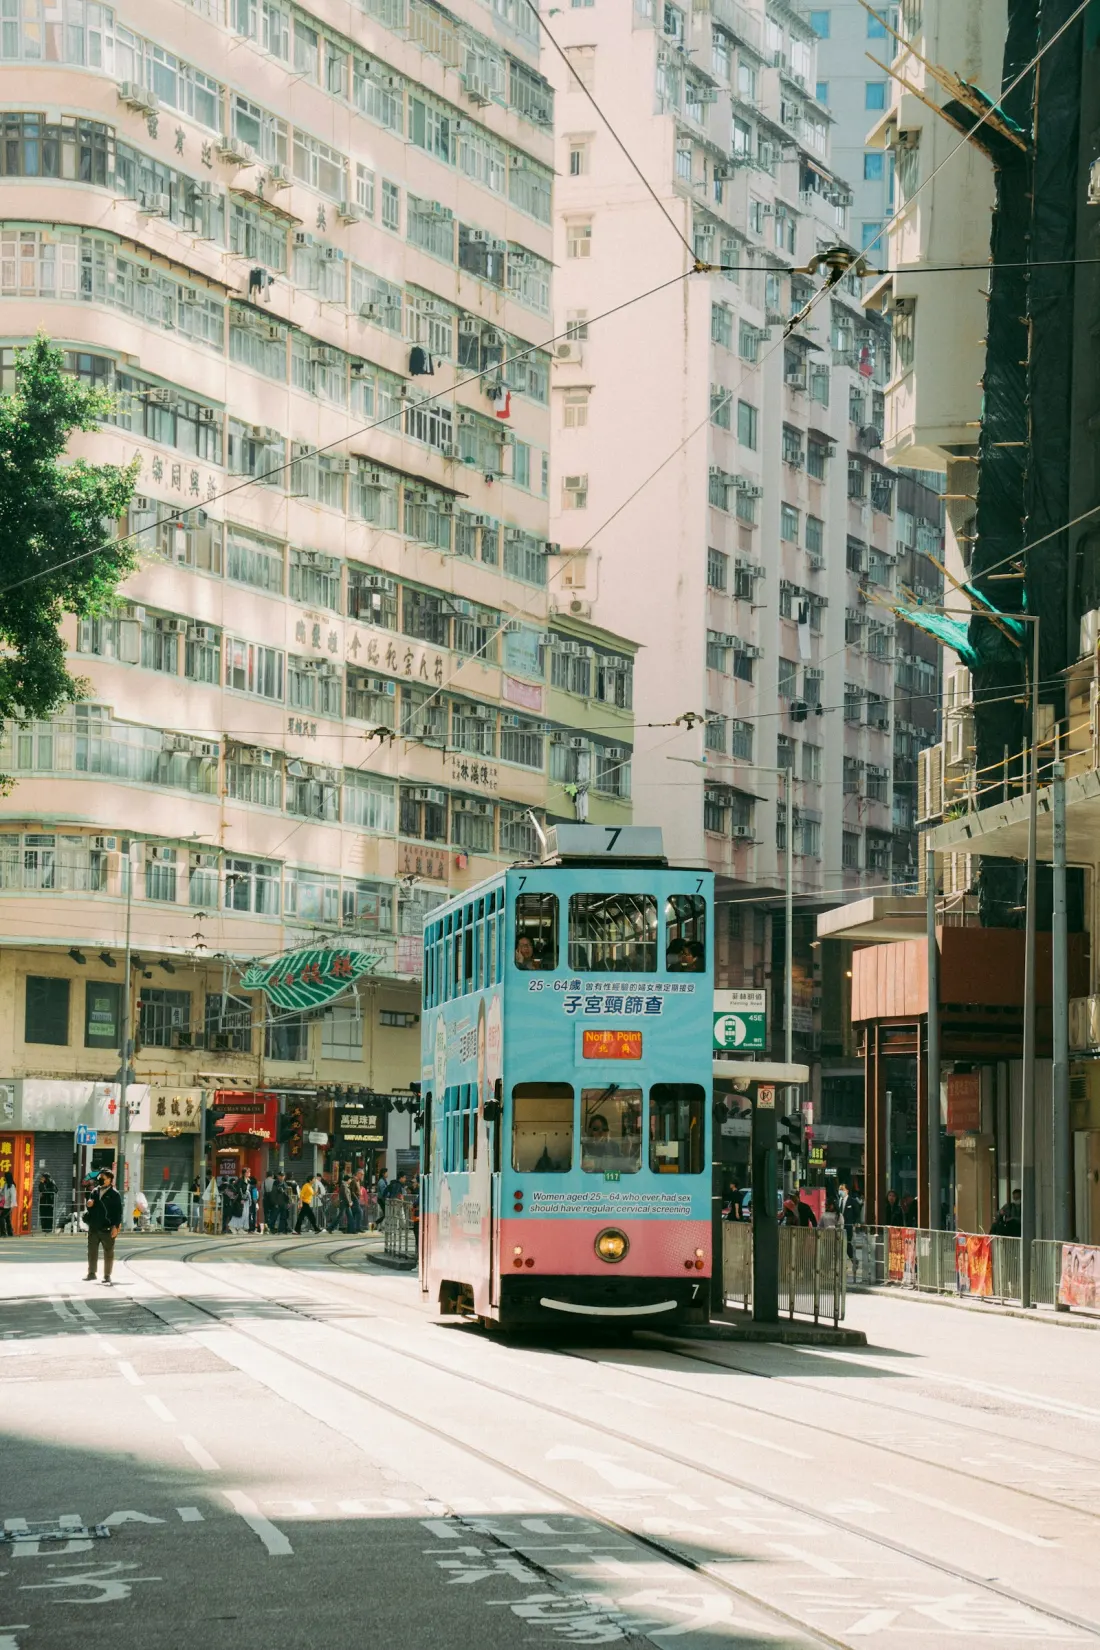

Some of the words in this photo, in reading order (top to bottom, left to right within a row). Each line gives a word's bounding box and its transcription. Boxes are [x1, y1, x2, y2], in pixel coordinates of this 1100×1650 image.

[604, 827, 622, 851] 7
[518, 876, 527, 891] 7
[696, 879, 704, 893] 7
[564, 995, 663, 1015] 子宮頸篩查
[586, 1032, 614, 1042] North
[617, 1032, 642, 1042] Point
[605, 1173, 619, 1181] 117
[533, 1192, 565, 1201] Women
[566, 1193, 588, 1202] aged
[622, 1193, 640, 1201] who
[661, 1194, 676, 1202] had
[530, 1204, 558, 1213] should
[560, 1204, 582, 1213] have
[583, 1205, 615, 1214] regular
[616, 1204, 650, 1213] cervical
[651, 1206, 691, 1215] screening
[691, 1284, 700, 1300] 7
[418, 1516, 832, 1541] ROAD
